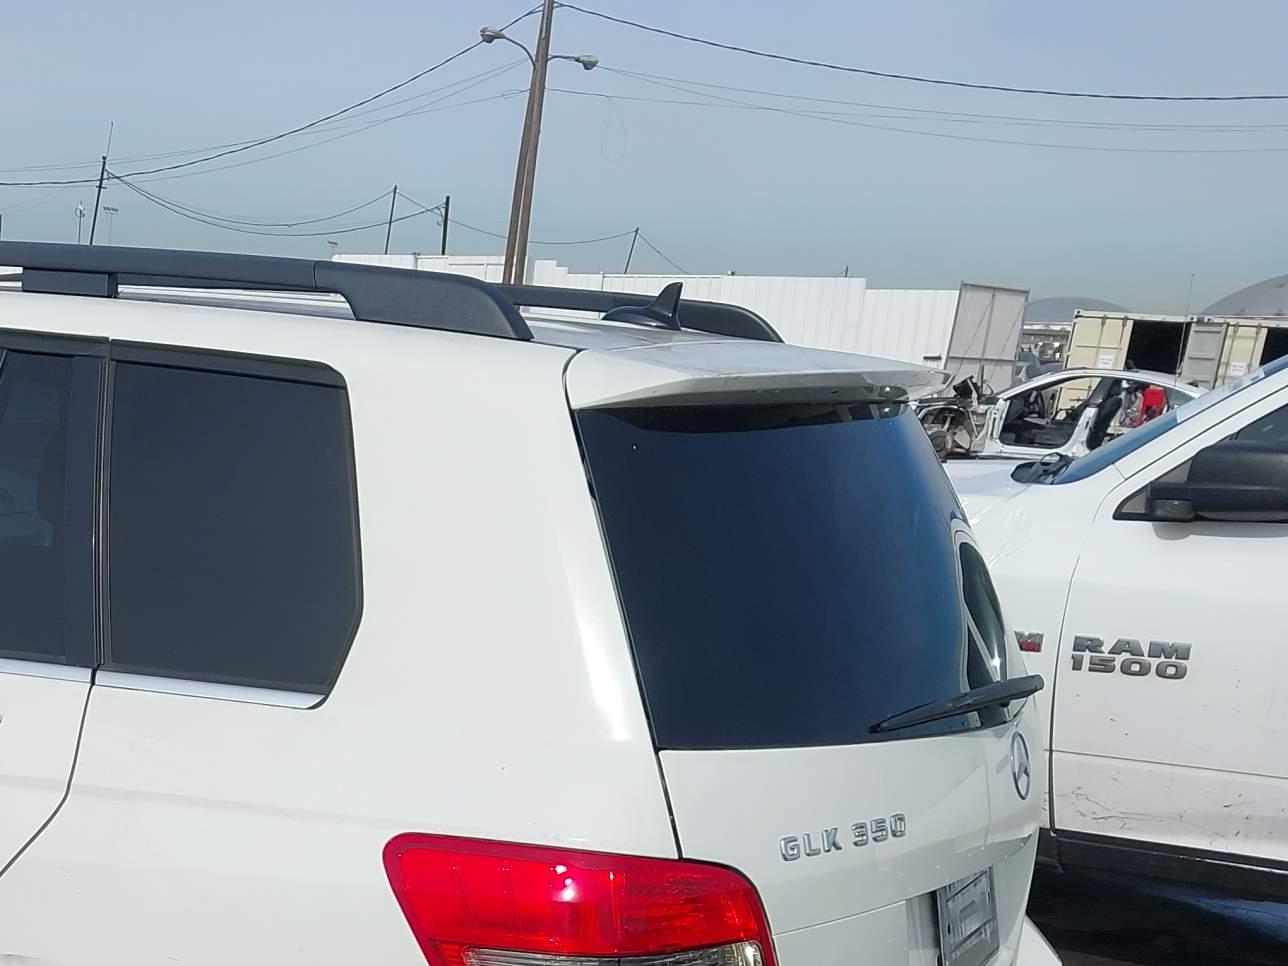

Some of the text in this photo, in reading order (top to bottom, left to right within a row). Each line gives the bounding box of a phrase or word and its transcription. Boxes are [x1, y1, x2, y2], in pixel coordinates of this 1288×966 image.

[1072, 635, 1192, 660] RAM
[1071, 653, 1188, 680] 1500
[779, 813, 906, 861] GLK 350
